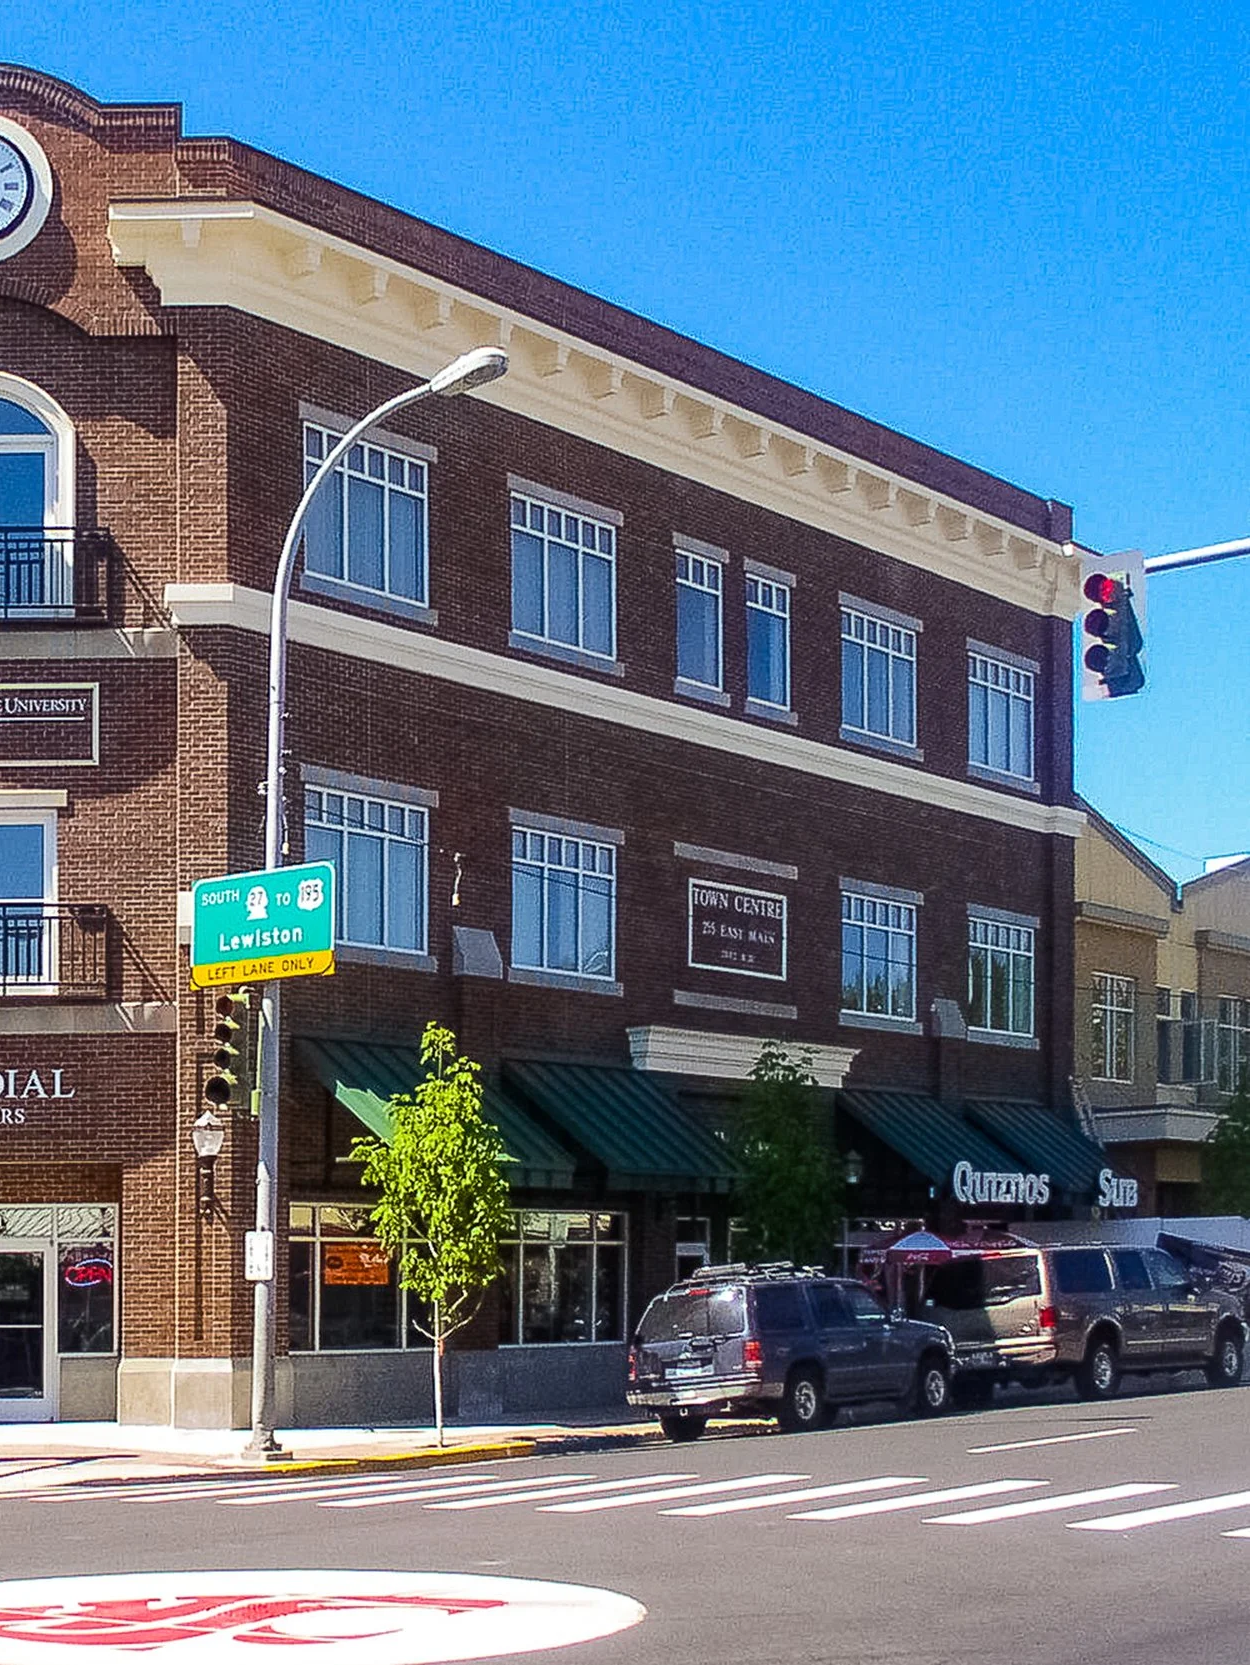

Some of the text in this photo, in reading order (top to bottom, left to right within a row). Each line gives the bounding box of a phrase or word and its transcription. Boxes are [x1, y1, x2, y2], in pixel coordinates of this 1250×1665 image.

[4, 697, 87, 713] UNIVERSITY
[201, 884, 319, 906] SOUTH 27 TO 195
[693, 887, 783, 919] TOWN CENTRE
[219, 926, 303, 952] Lewiston
[720, 924, 743, 940] EAST
[207, 957, 315, 981] LEFT LANE ONLY
